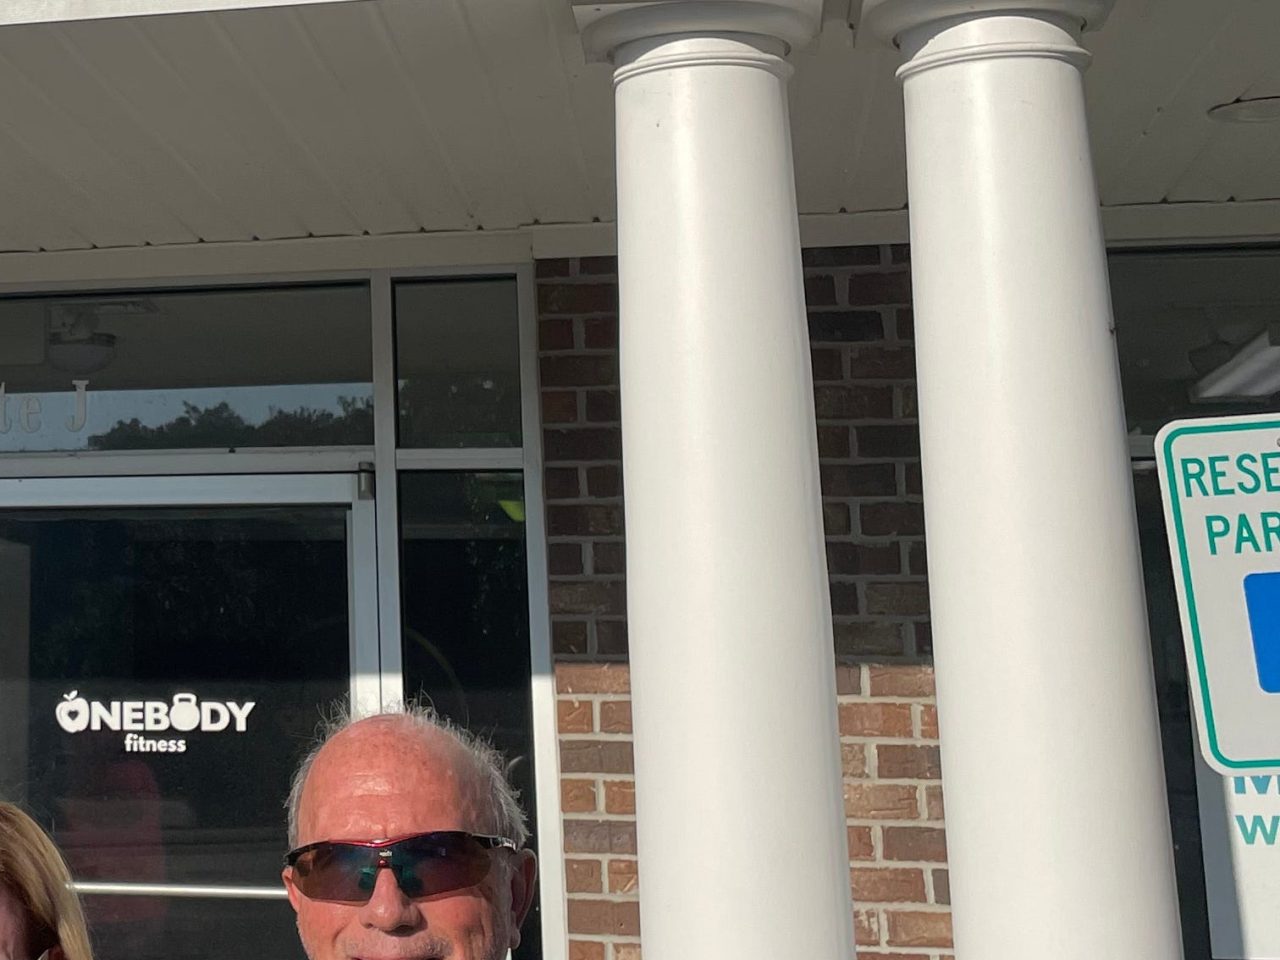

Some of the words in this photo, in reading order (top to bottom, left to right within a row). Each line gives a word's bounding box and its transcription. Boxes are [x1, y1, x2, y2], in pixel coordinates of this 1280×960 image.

[66, 380, 89, 433] J
[1205, 511, 1280, 555] PAR
[55, 690, 256, 733] ONEBODY
[124, 734, 186, 752] fitness
